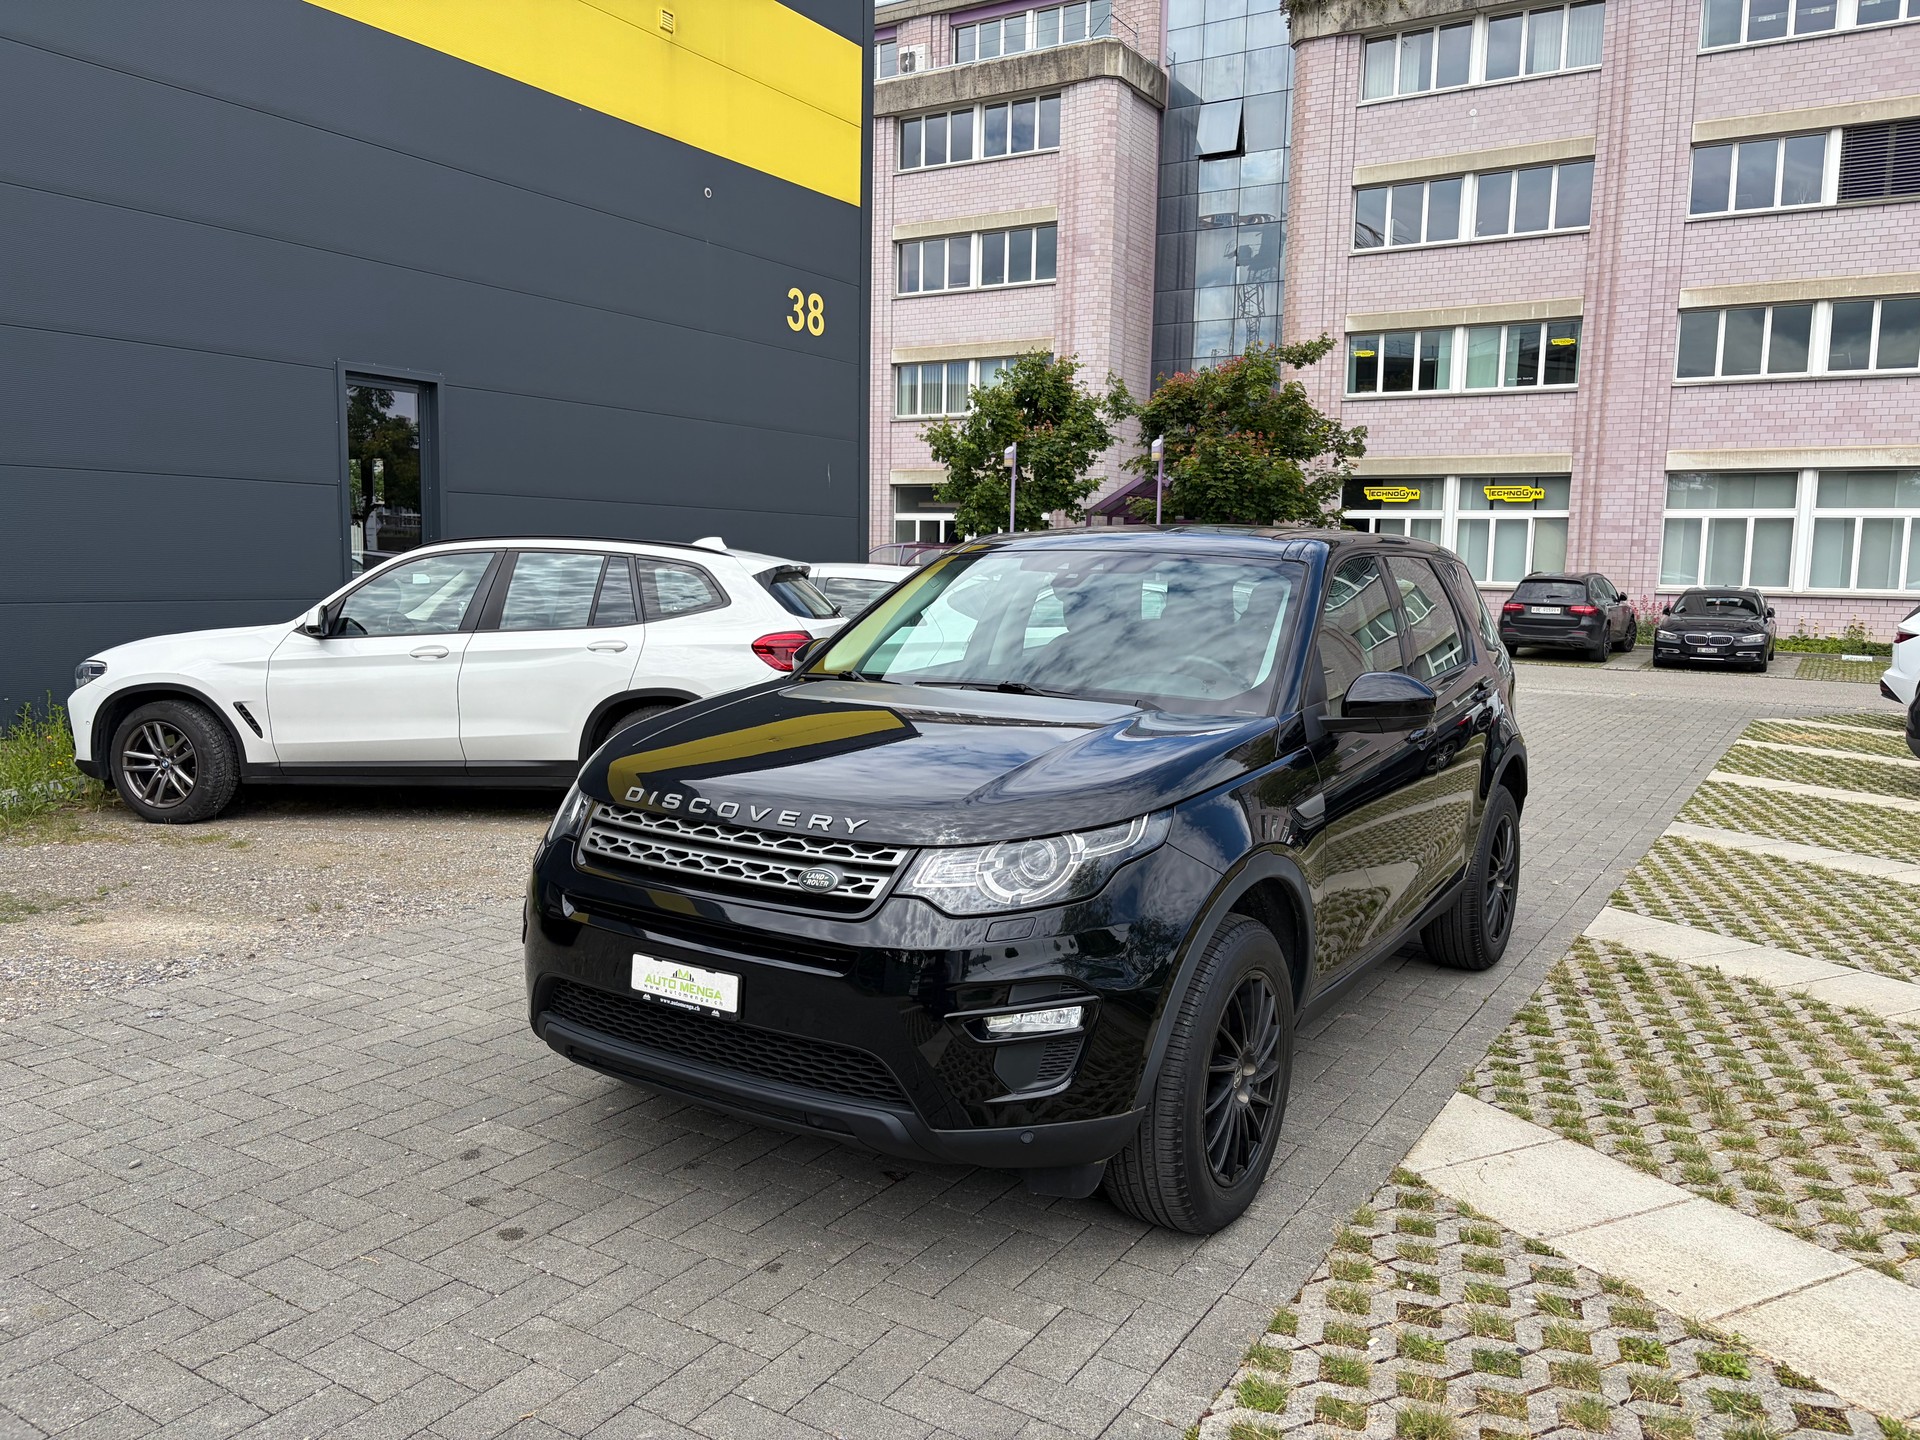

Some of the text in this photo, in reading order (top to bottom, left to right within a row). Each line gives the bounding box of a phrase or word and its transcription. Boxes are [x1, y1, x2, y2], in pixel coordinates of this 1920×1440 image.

[786, 287, 825, 337] 38
[625, 786, 869, 834] DISCOVERY
[644, 974, 722, 1000] AUTO MENGA
